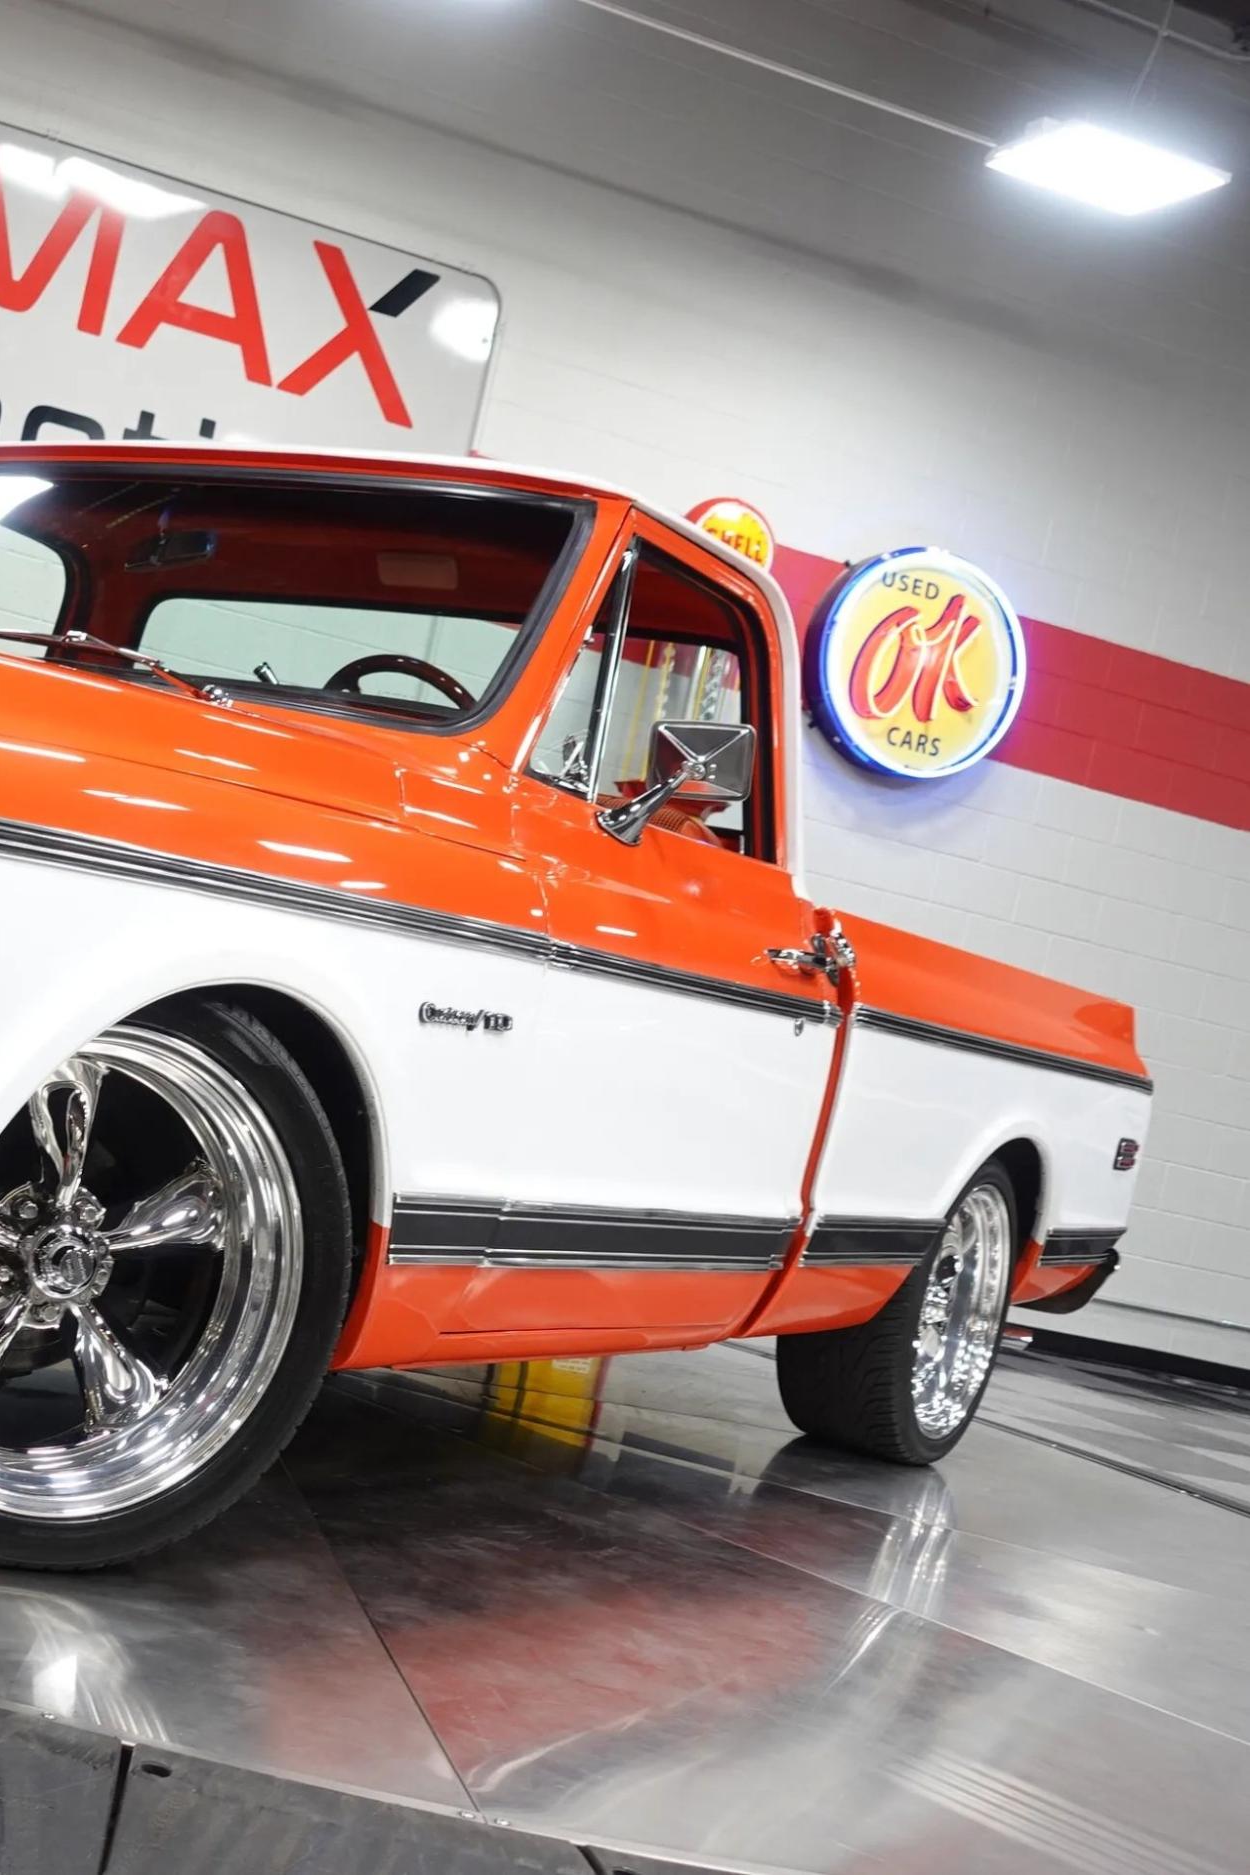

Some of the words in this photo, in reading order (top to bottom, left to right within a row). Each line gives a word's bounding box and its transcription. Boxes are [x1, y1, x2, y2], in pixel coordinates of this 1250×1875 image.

[706, 528, 763, 565] HELL
[882, 571, 940, 600] USED
[848, 594, 981, 724] OK
[886, 726, 941, 757] CARS
